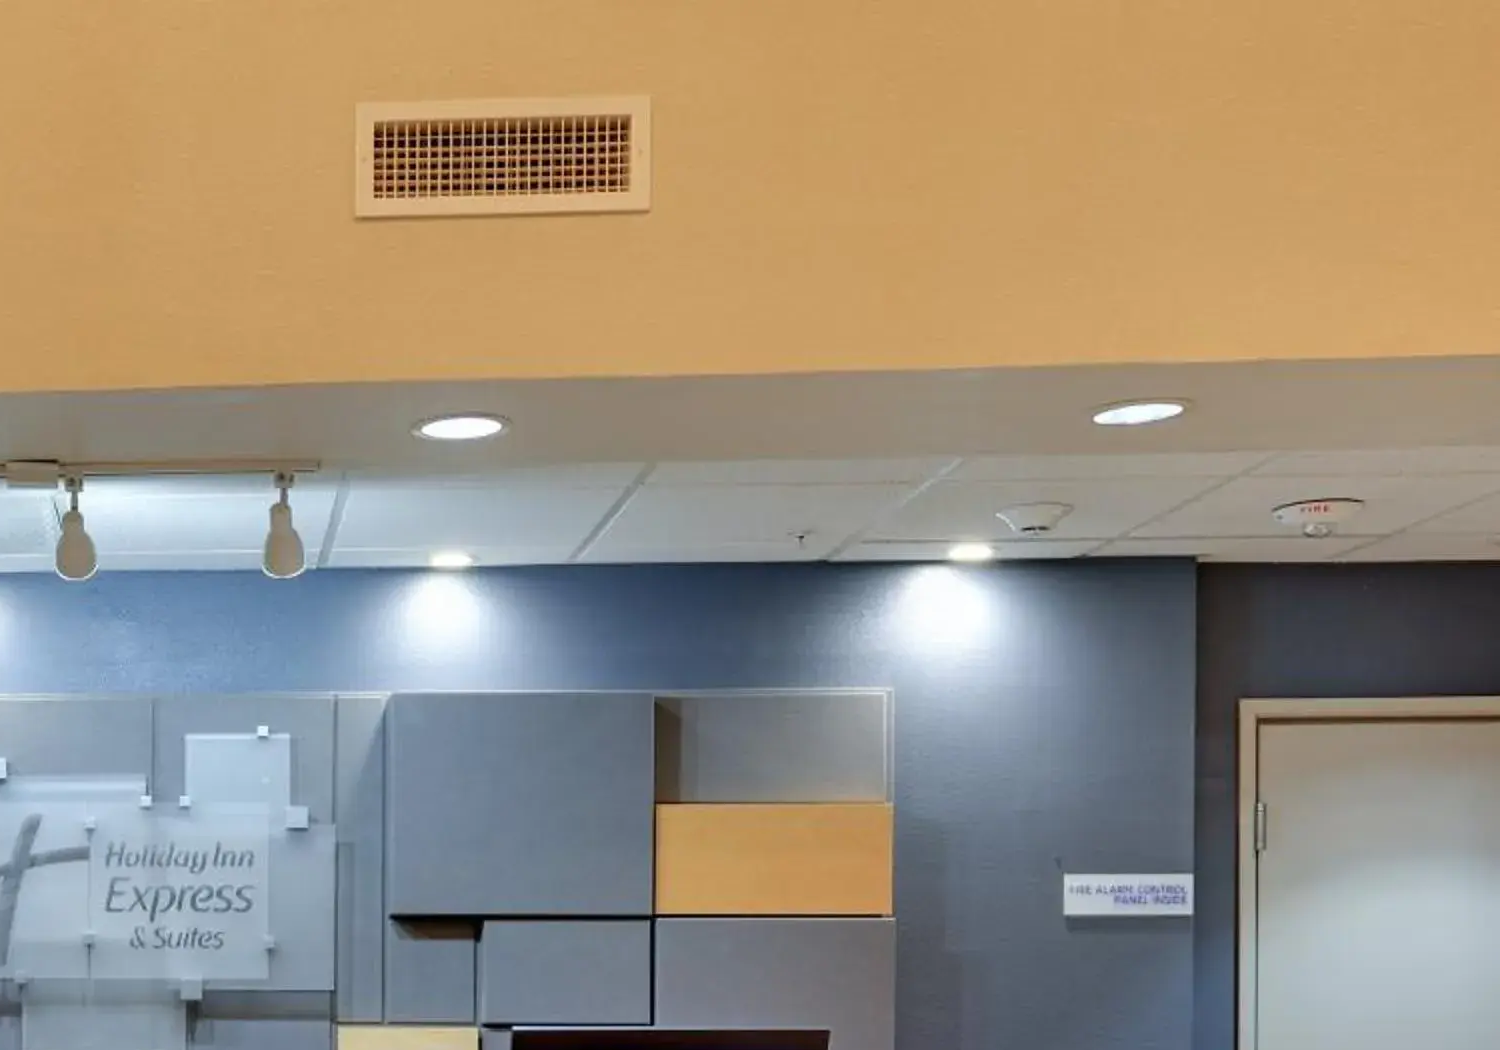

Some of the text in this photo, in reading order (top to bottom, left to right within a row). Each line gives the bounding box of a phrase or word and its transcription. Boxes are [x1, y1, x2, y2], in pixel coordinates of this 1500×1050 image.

[105, 841, 255, 874] Holiday Inn
[105, 876, 256, 923] Express
[1069, 884, 1188, 896] FIRE ALARM CONTROL
[1113, 895, 1149, 905] PANEL
[129, 926, 226, 950] & Suites
